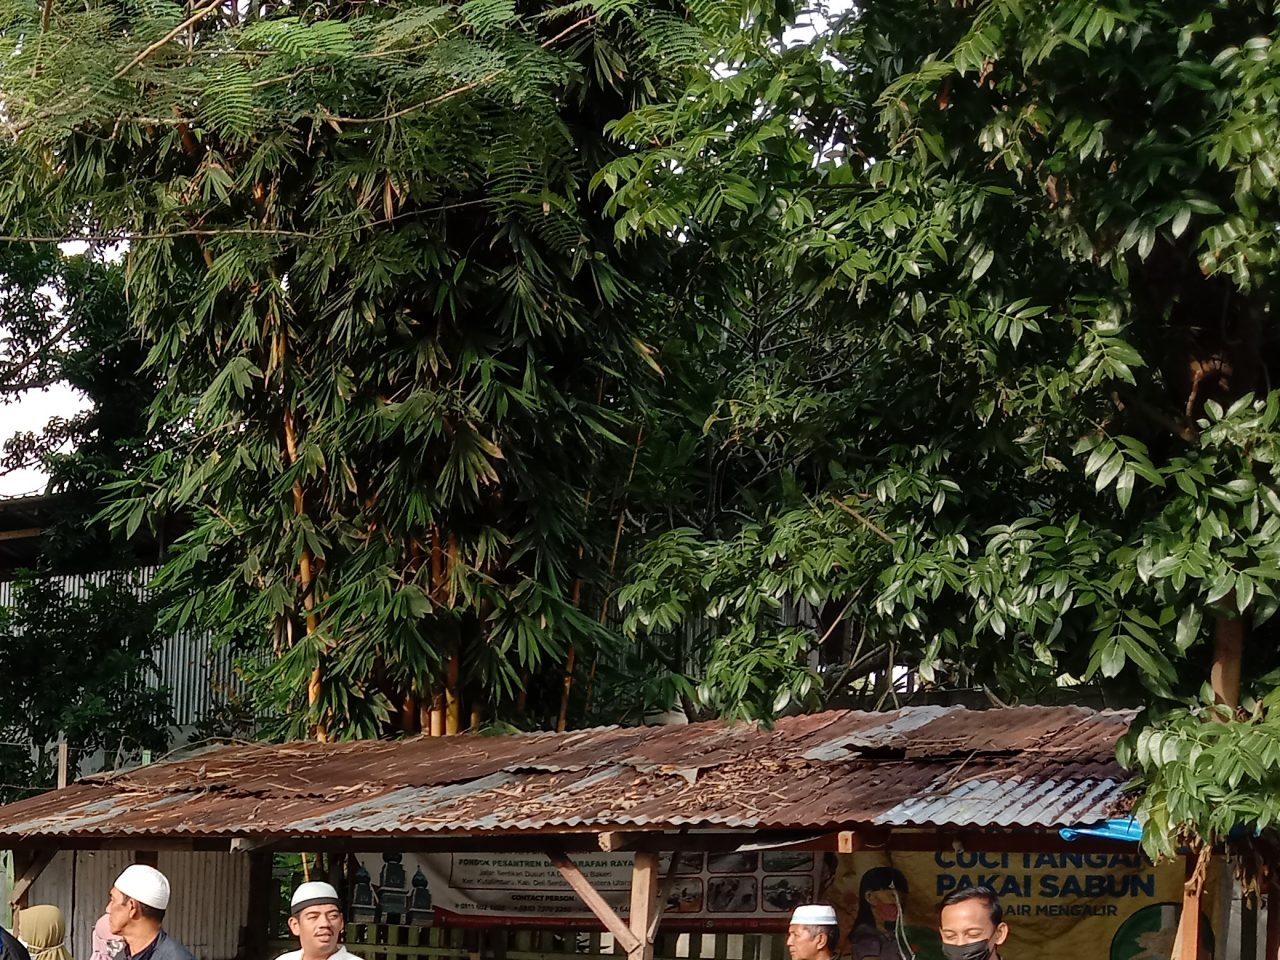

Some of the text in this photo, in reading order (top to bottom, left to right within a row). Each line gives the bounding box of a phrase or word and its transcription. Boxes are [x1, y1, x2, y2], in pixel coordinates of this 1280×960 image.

[492, 859, 543, 868] PESANTREN
[610, 860, 634, 868] RAYA
[934, 850, 1008, 869] CUCI
[936, 874, 1155, 898] PAKAI SABUN
[1005, 904, 1118, 917] AIR MENGALIR
